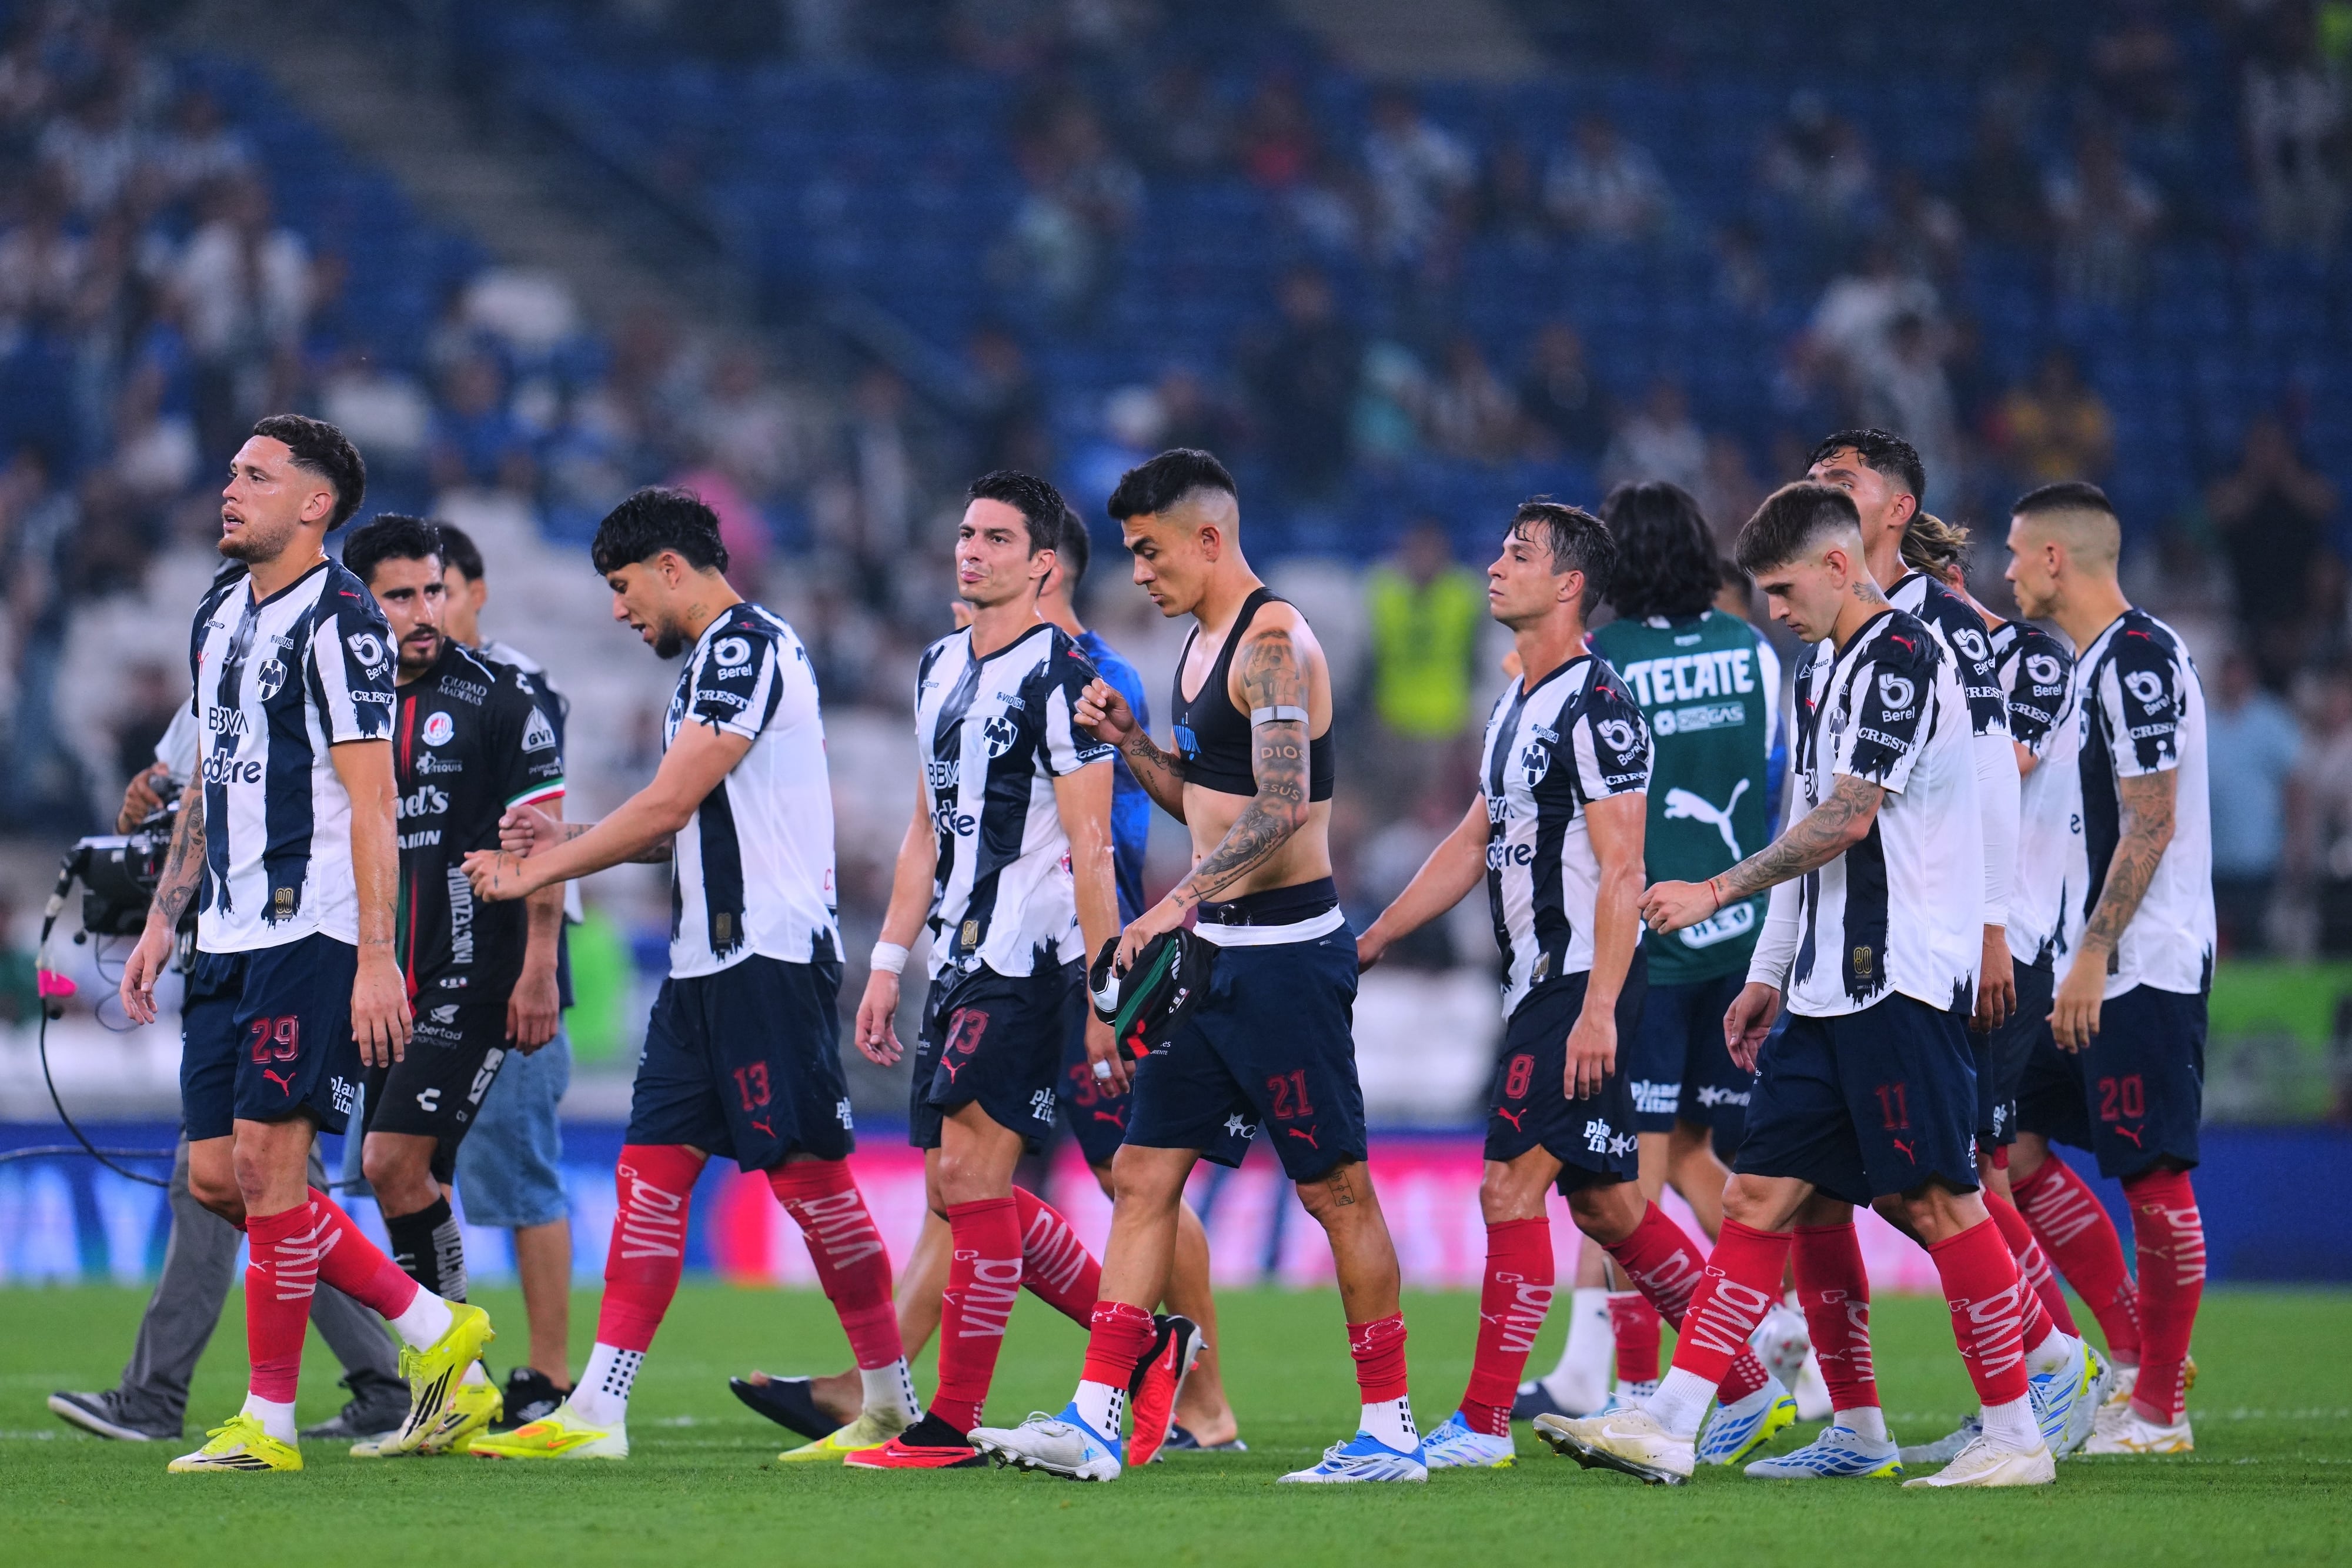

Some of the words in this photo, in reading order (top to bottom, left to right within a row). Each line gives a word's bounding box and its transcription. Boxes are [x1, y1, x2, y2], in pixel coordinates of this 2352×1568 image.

[365, 657, 389, 681] Berel
[717, 663, 753, 681] Berel
[1623, 648, 1755, 706] TECATE
[350, 690, 394, 704] CREST
[437, 684, 483, 706] MADERAS
[441, 675, 487, 697] CIUDAD
[2033, 684, 2062, 697] Berel
[696, 690, 749, 710] CREST
[209, 707, 249, 735] BBVA
[1882, 706, 1915, 723] Berel
[1857, 727, 1909, 754] CREST
[1261, 745, 1307, 763] DIOS
[1258, 782, 1301, 801] ESÚS
[1853, 947, 1872, 974] 80
[251, 1014, 299, 1064] 29
[733, 1061, 771, 1112] 13
[1505, 1054, 1535, 1099] 8
[1267, 1069, 1315, 1120] 21
[1875, 1082, 1910, 1131] 11
[2099, 1074, 2145, 1121] 20
